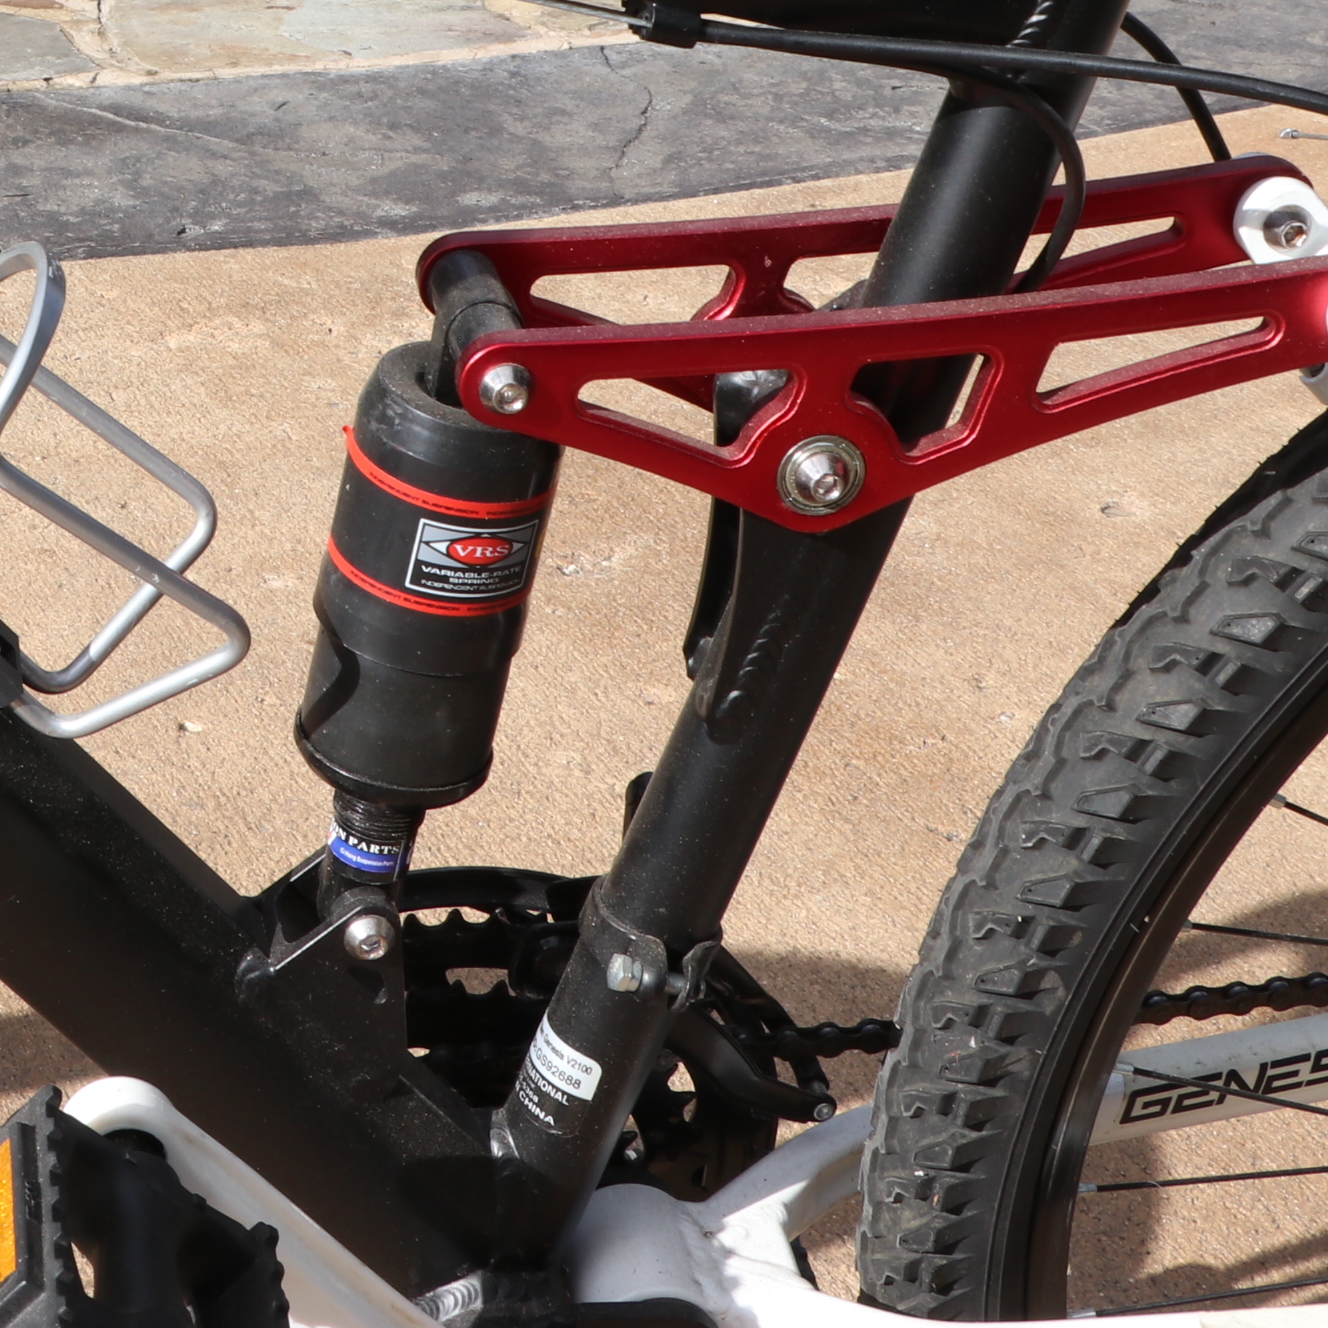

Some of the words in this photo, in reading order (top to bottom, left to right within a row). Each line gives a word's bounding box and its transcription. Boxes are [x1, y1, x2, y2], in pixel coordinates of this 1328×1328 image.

[453, 543, 510, 558] VRS
[421, 565, 522, 579] VARIABLE-RATE
[448, 576, 500, 585] SPRING
[347, 835, 401, 854] PARTS
[566, 1054, 593, 1076] V2100
[519, 1090, 555, 1126] CHINA
